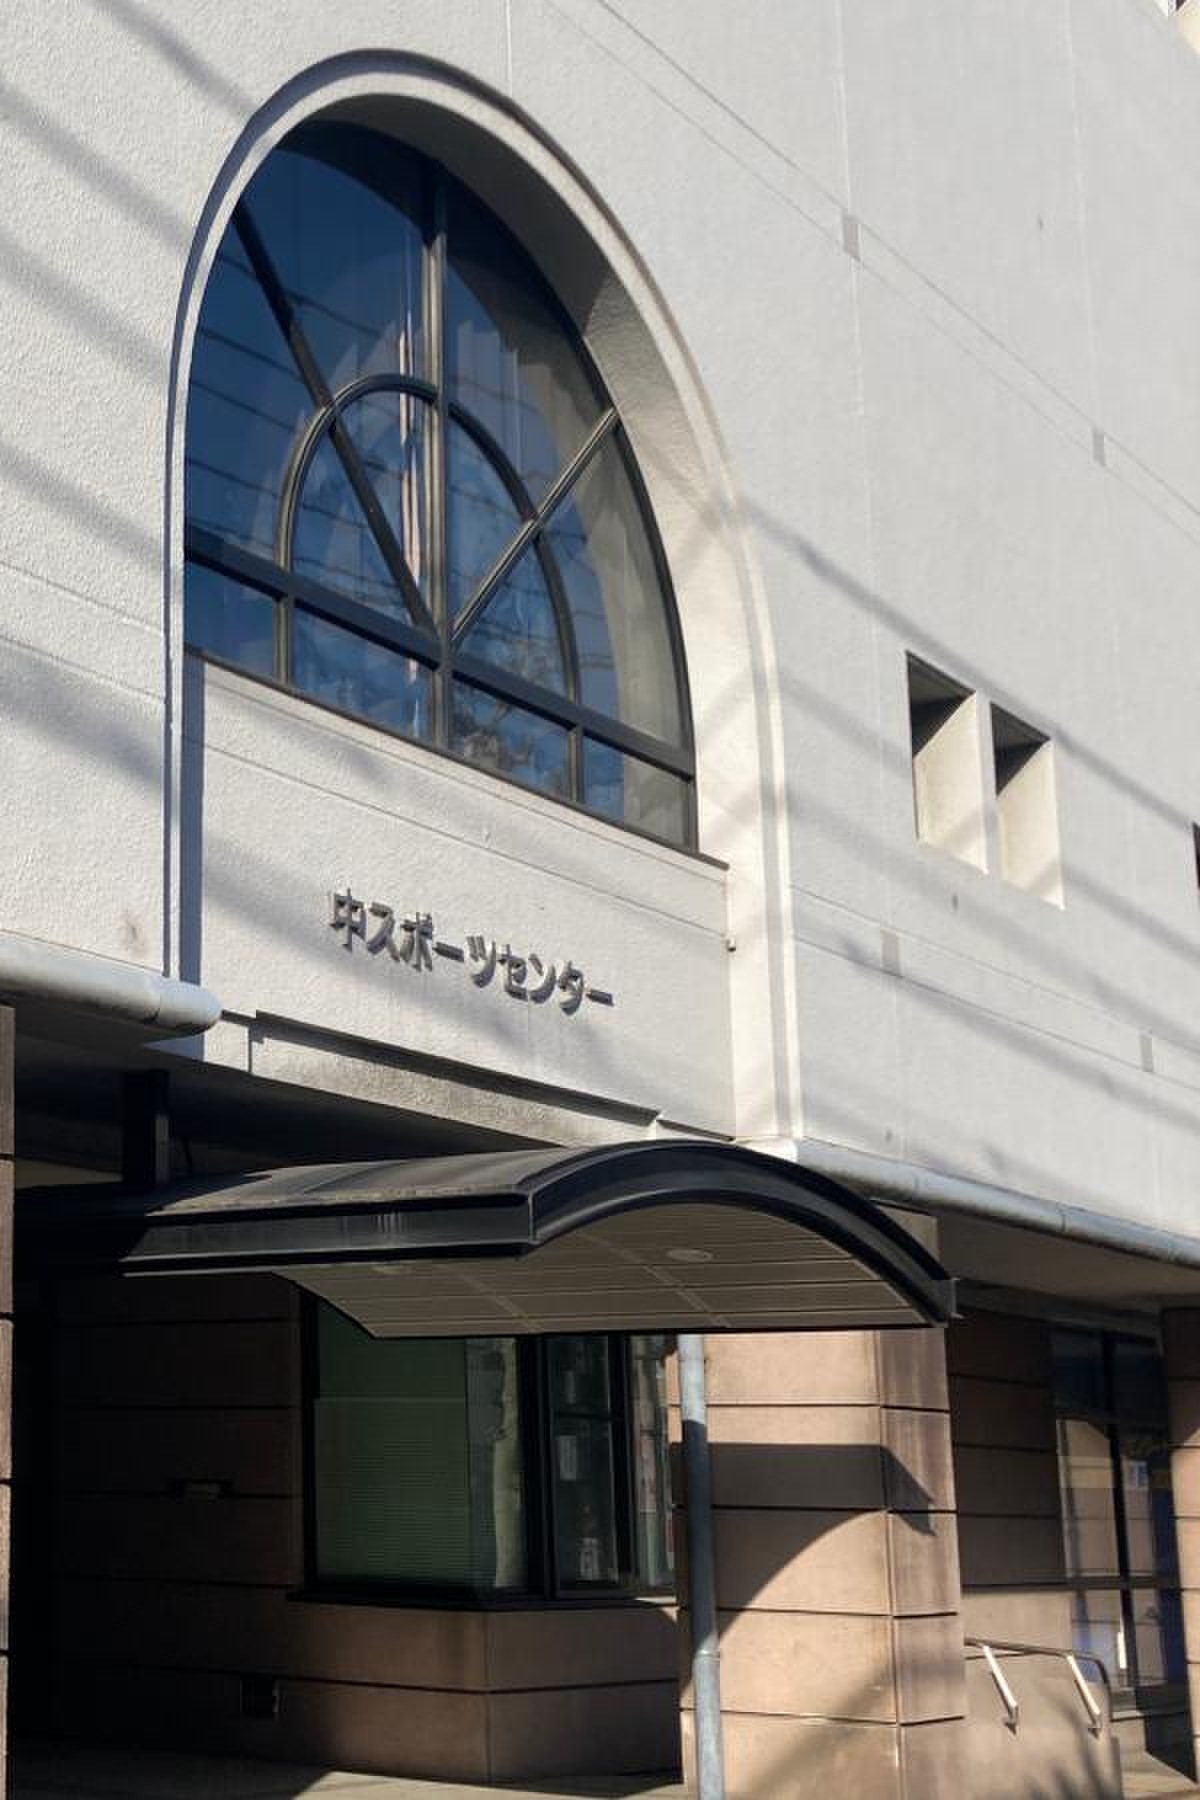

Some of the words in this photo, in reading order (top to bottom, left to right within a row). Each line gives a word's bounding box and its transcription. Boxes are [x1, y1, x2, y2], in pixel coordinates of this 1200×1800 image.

[330, 887, 614, 1015] 中スポーツセンター
